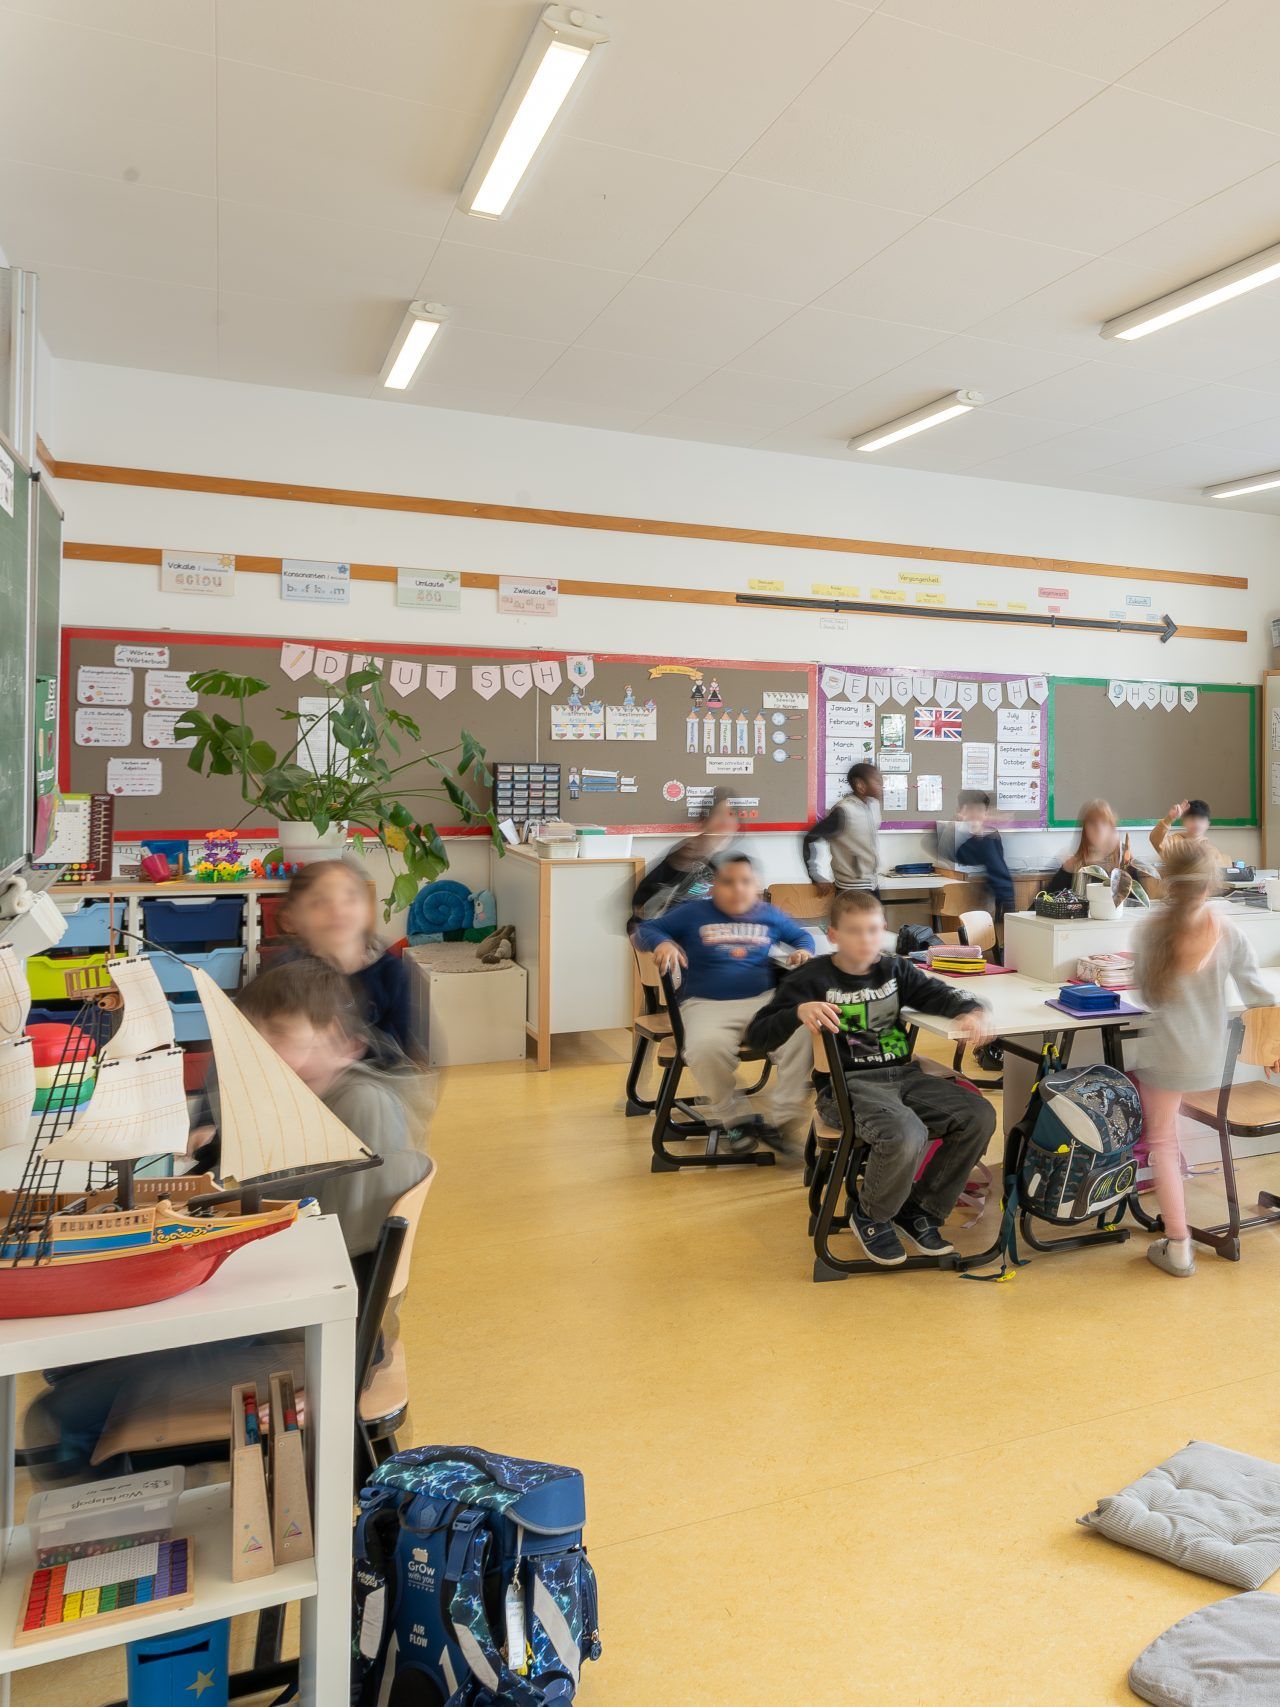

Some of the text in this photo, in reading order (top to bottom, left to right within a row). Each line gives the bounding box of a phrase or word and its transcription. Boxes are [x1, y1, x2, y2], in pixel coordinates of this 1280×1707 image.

[168, 561, 196, 571] Vokale
[283, 571, 326, 580] Konsonanten
[899, 574, 939, 584] Vergangenheit
[415, 580, 445, 588] Umlaute
[513, 587, 547, 596] Zwielaute
[851, 679, 1022, 701] ENGLISCH
[1131, 687, 1175, 703] HSU
[830, 704, 859, 713] January
[1006, 712, 1020, 720] July
[829, 717, 860, 727] February
[833, 741, 854, 749] March
[999, 745, 1030, 753] September
[835, 753, 852, 761] April
[825, 977, 899, 1004] ADVENTURE
[408, 1560, 435, 1576] GrOw
[408, 1571, 435, 1585] with you
[413, 1623, 425, 1635] AIR
[409, 1634, 428, 1648] FLOW
